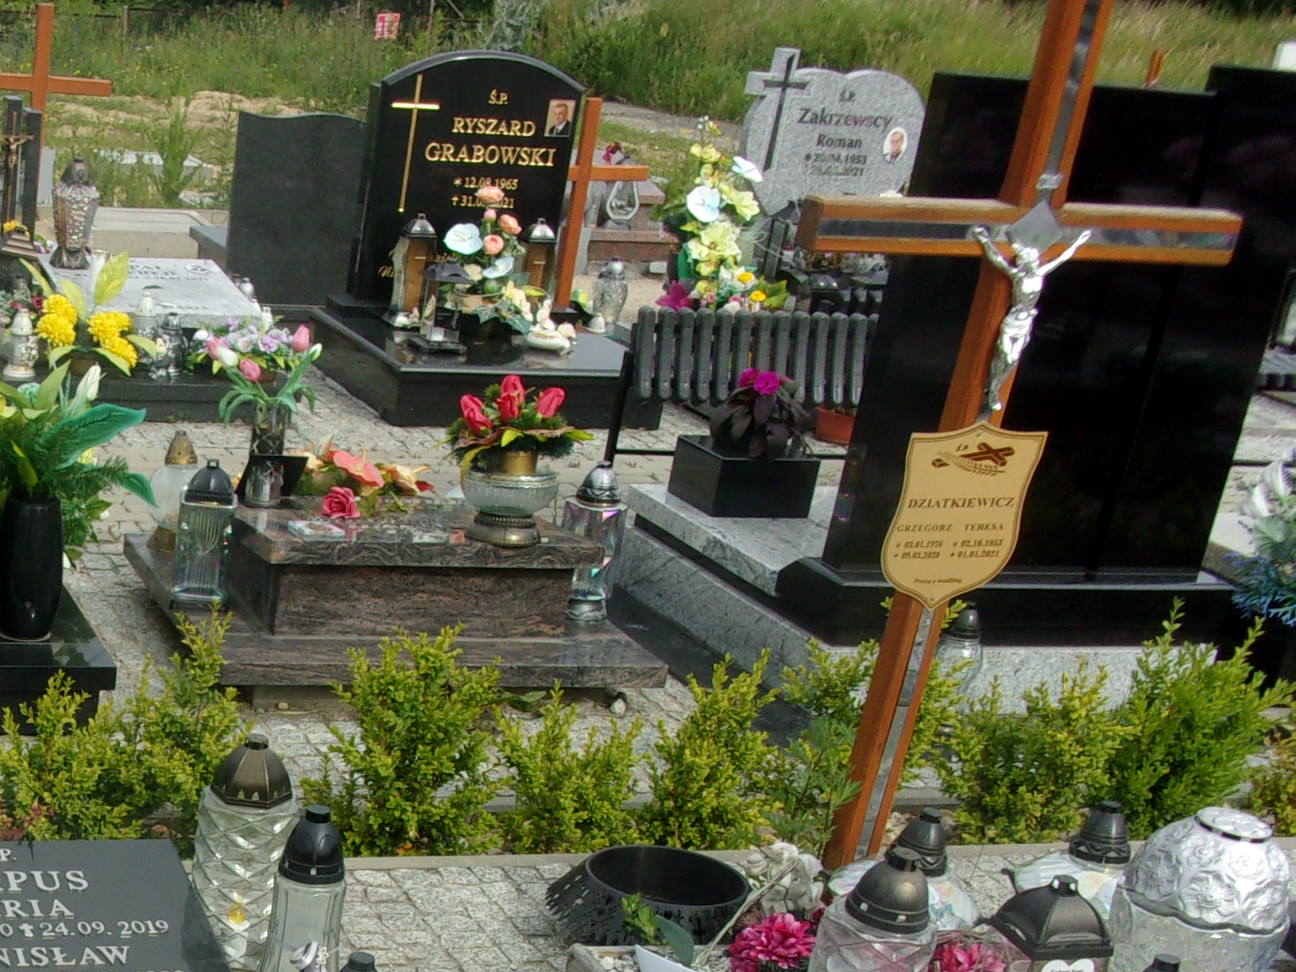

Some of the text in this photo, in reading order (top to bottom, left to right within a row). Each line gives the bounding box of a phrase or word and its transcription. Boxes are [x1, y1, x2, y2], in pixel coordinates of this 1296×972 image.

[451, 117, 536, 136] RYSZARD
[798, 107, 893, 133] Zakrzewscy
[816, 133, 863, 148] Roman
[424, 142, 556, 167] GRABOWSKI
[908, 497, 1016, 510] DZIATKIEWICZ
[896, 523, 1004, 533] GRZEGORZ TERESA
